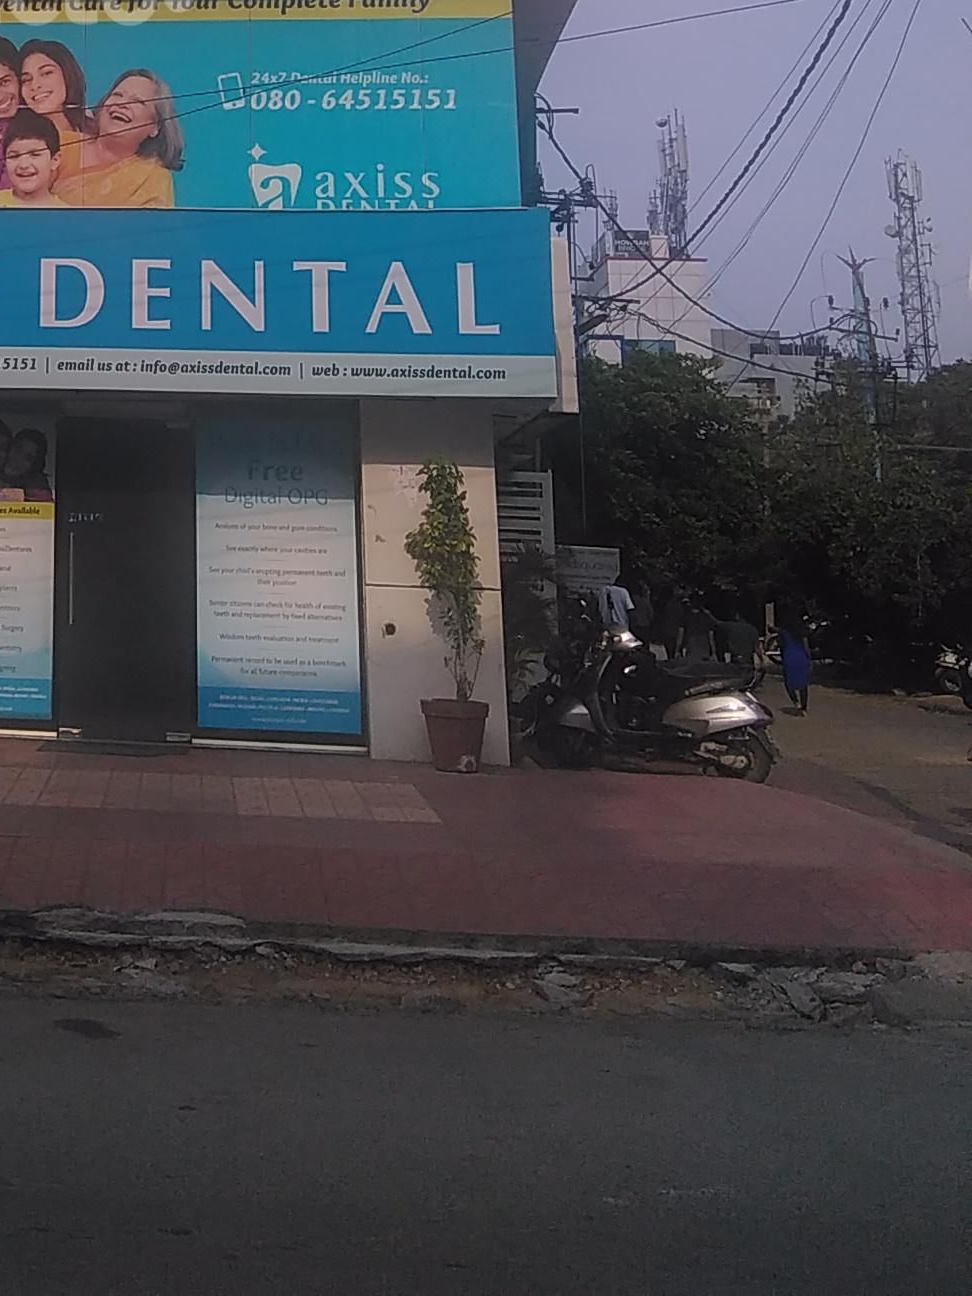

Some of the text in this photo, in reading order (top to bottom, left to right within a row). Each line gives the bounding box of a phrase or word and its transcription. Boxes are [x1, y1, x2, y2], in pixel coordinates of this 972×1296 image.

[250, 71, 287, 84] 24x7
[340, 71, 398, 88] Helpline
[250, 88, 301, 110] 080
[321, 88, 458, 110] 64515151
[314, 163, 441, 199] axiss
[39, 256, 501, 335] DENTAL
[57, 358, 95, 372] email
[97, 362, 112, 372] us
[140, 359, 292, 376] info@axissdental.com
[351, 364, 507, 380] www.axissdental.com
[248, 459, 304, 481] Free
[225, 486, 329, 509] Digital OPG
[8, 506, 40, 515] Available
